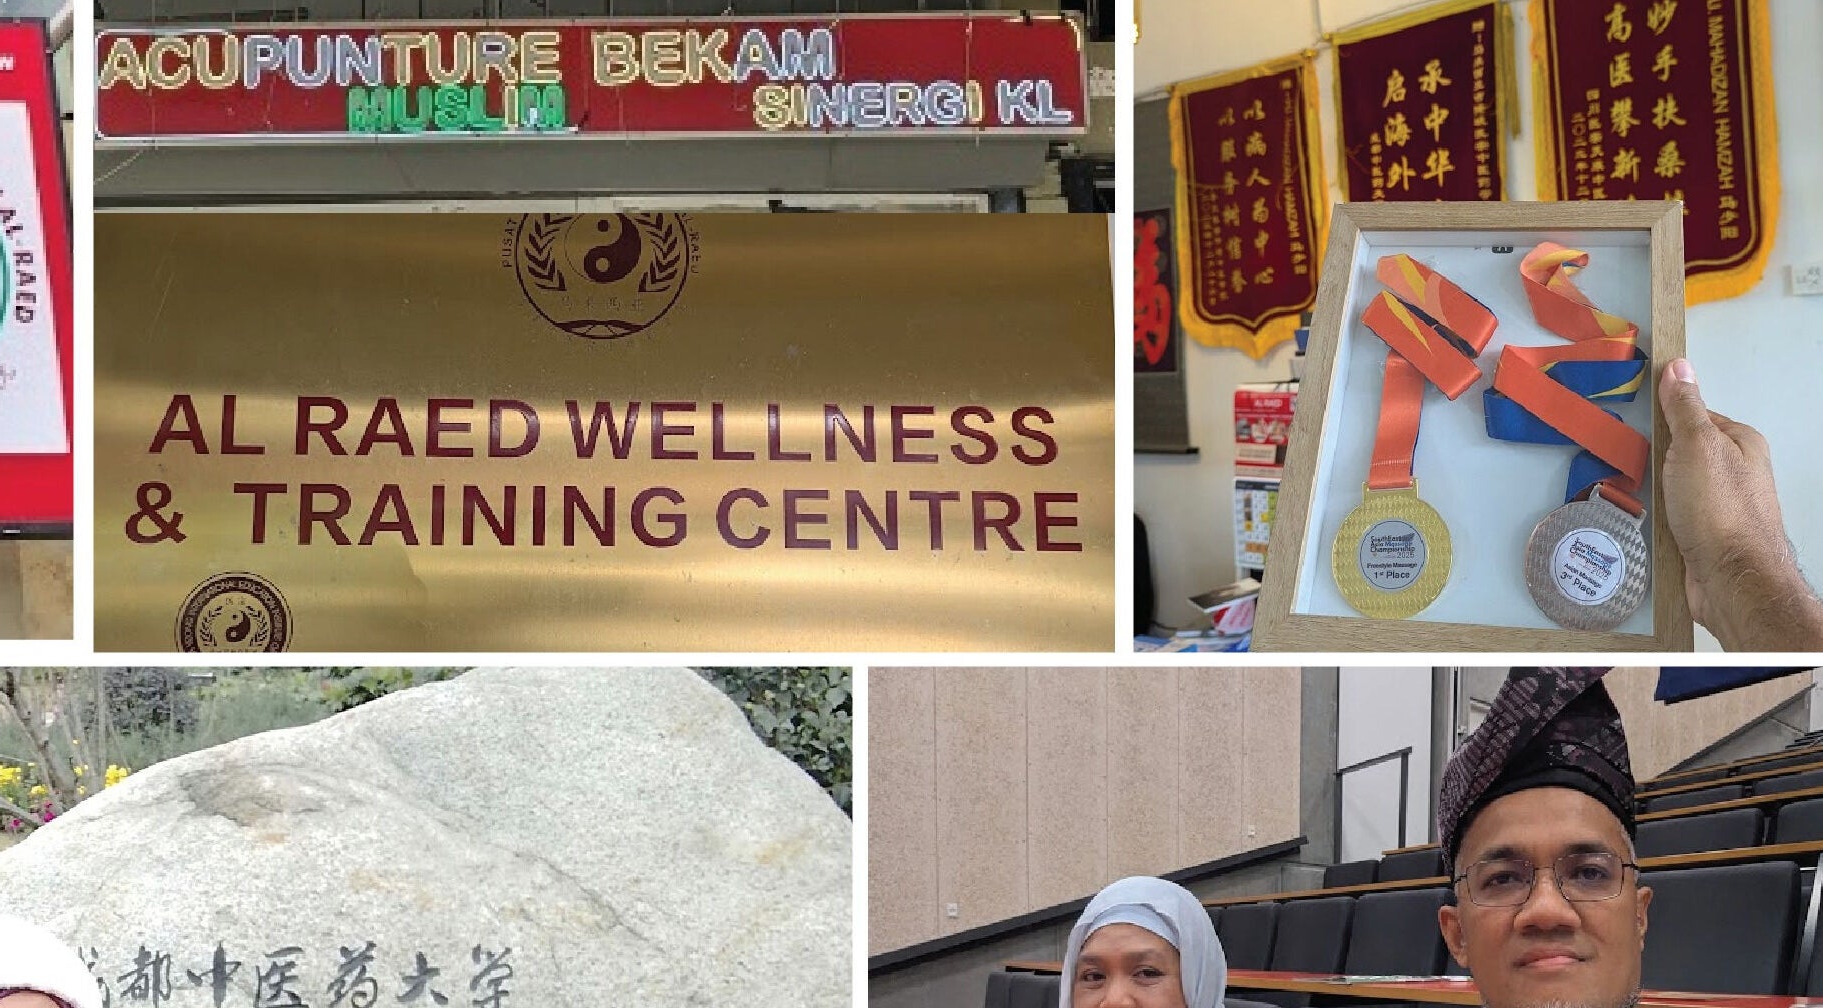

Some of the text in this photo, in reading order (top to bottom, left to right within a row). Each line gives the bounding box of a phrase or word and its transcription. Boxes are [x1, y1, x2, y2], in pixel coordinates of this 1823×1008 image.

[97, 29, 837, 89] ACUPUNTURE BEKAM
[1708, 15, 1730, 114] MAHADIZAN
[347, 84, 566, 133] MUSLIM
[752, 79, 1074, 128] SINERGI KL
[1418, 59, 1455, 200] 承中华
[147, 394, 1060, 467] AL RAED WELLNESS
[125, 480, 1084, 552] & TRAINING CENTRE
[1386, 571, 1410, 579] Place
[1572, 578, 1597, 597] Place
